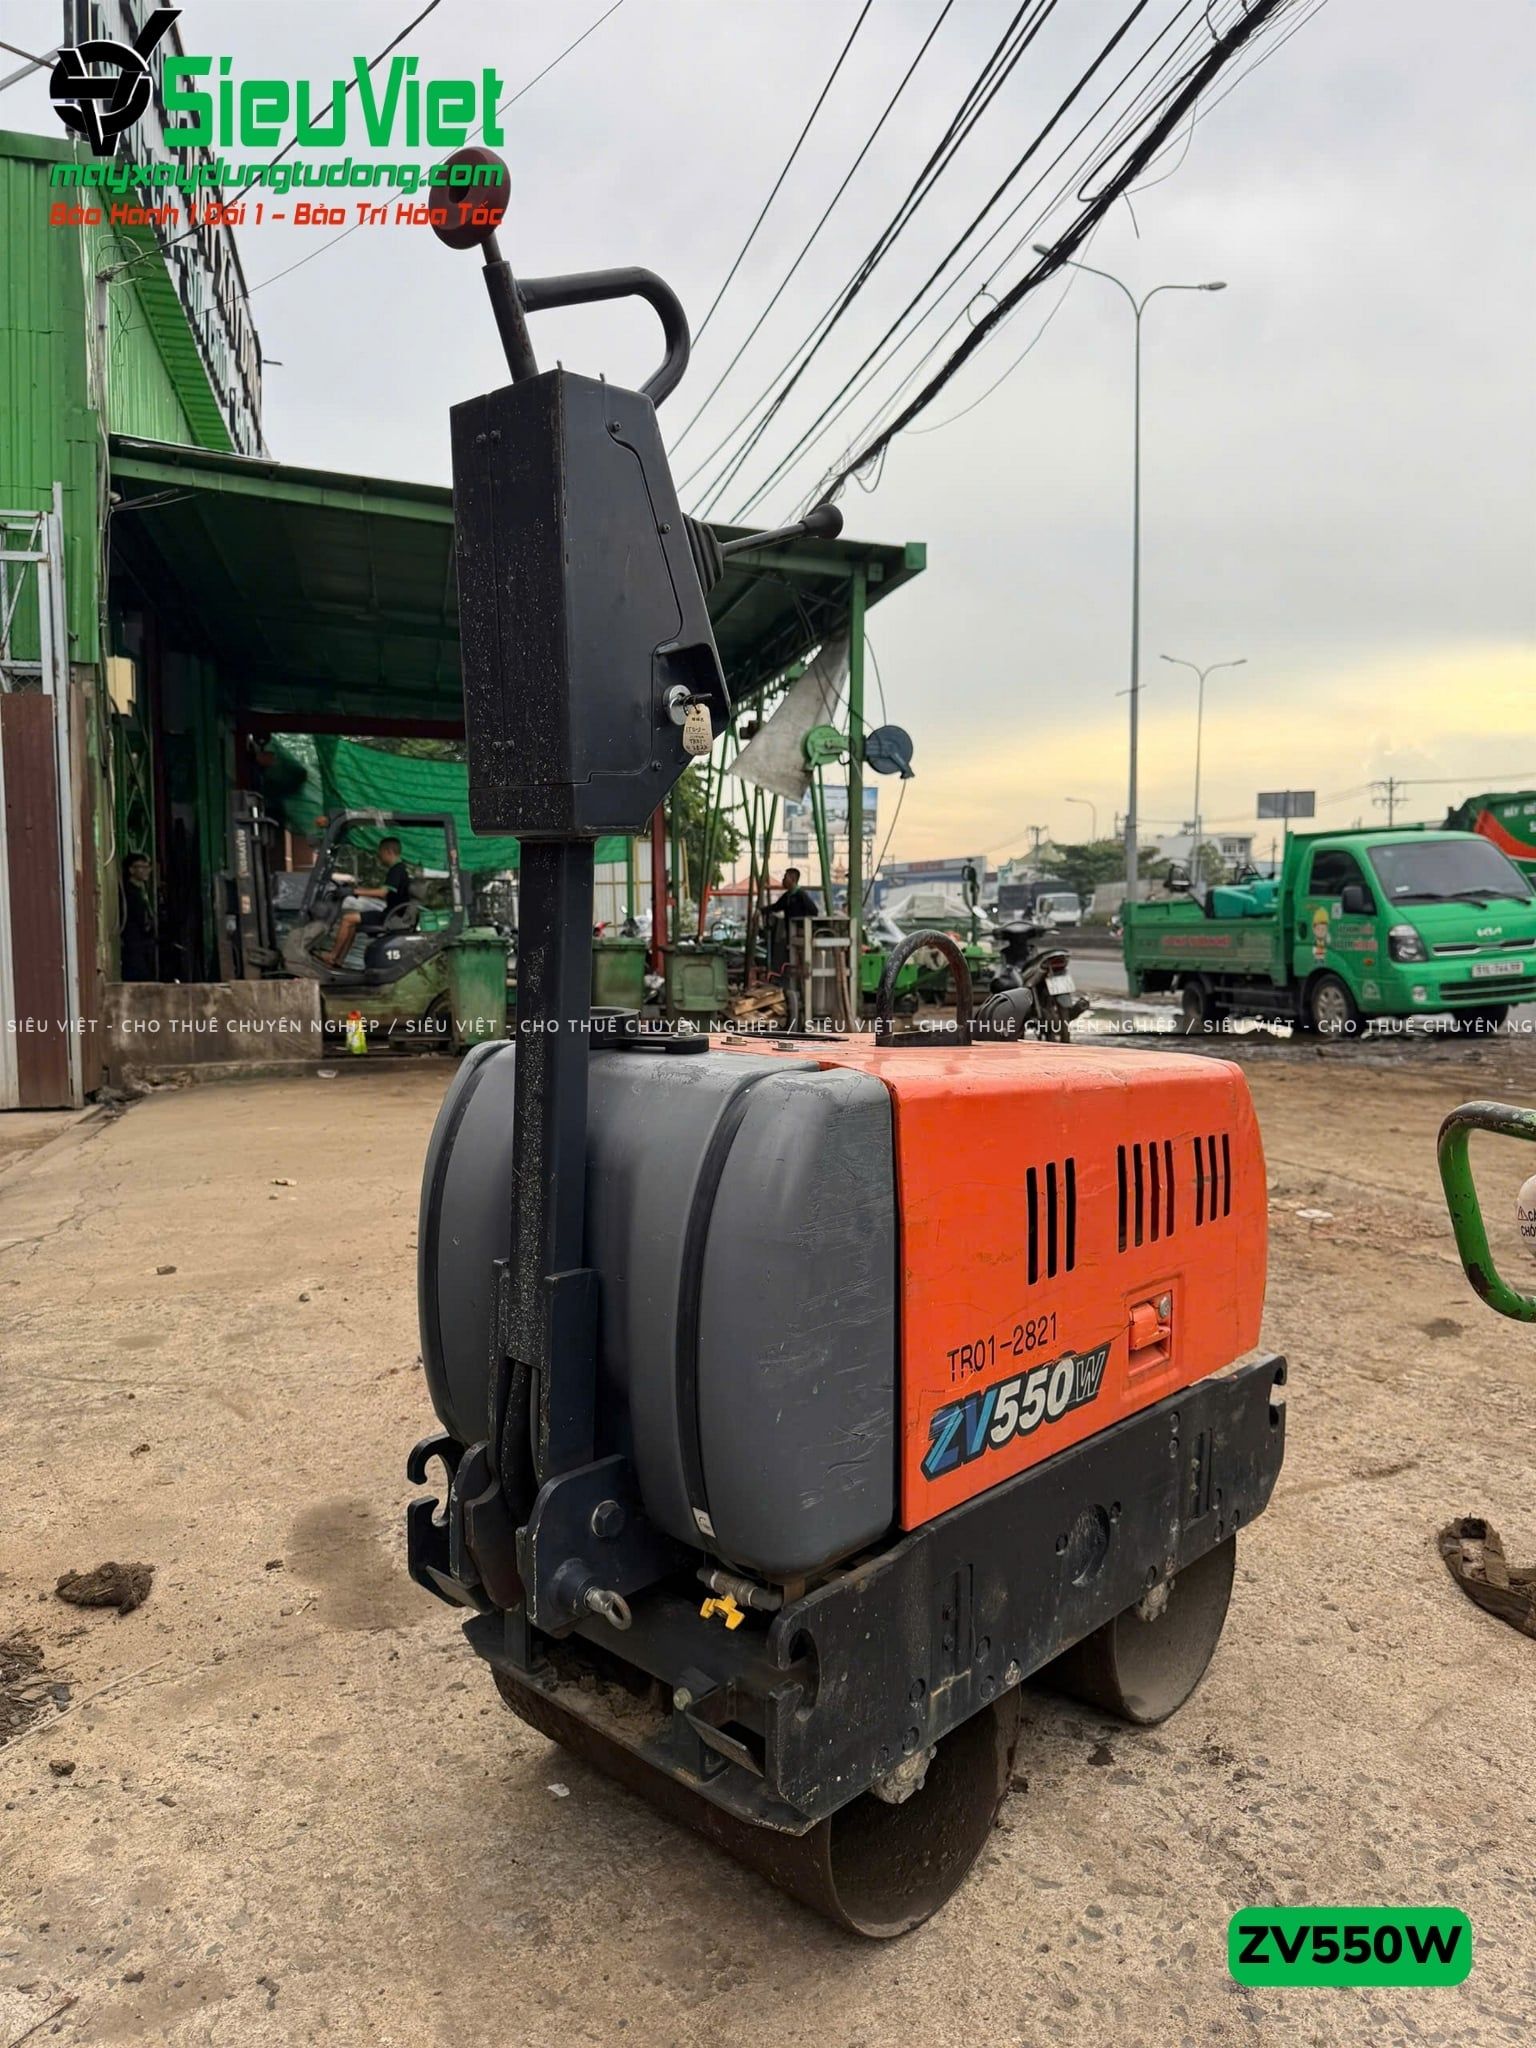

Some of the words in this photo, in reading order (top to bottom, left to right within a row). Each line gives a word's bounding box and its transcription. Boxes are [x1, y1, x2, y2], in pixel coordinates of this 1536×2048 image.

[385, 949, 401, 960] 15
[947, 1311, 1057, 1382] TR01-2821
[923, 1344, 1110, 1478] ZV550W
